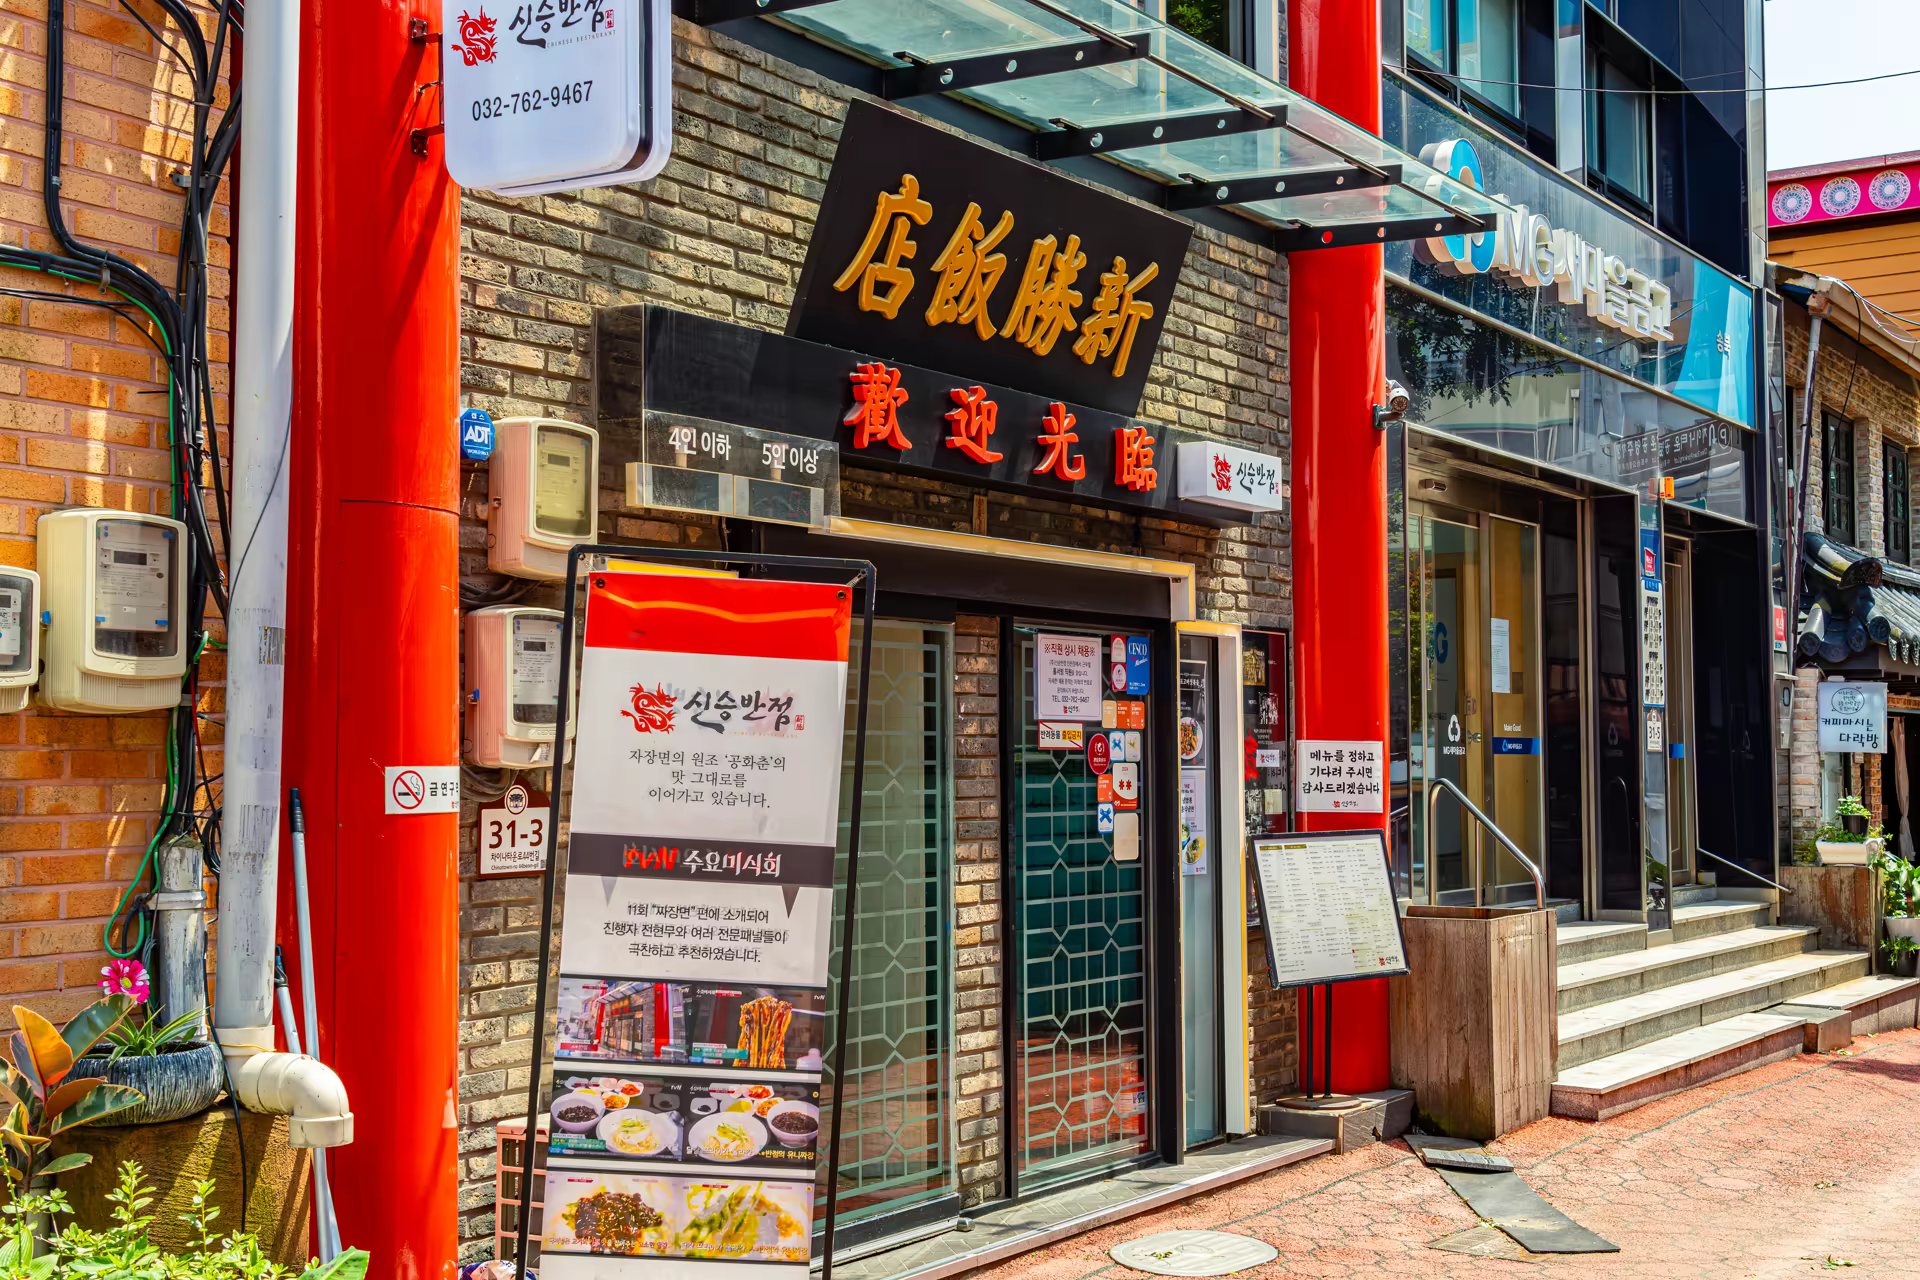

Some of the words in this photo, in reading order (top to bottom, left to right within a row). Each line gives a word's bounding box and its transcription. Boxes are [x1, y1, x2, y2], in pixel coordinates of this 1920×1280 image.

[546, 38, 573, 48] CHINESE
[576, 30, 616, 42] RESTAURANT
[472, 80, 593, 121] 032-762-9467
[464, 425, 490, 444] ADT
[668, 427, 697, 456] 4인
[700, 431, 732, 460] 이하
[762, 443, 786, 470] 5인
[789, 446, 818, 474] 이상
[1236, 462, 1275, 495] 신승반점
[682, 690, 794, 734] 신승반점
[1649, 726, 1660, 739] 31-5
[1821, 718, 1874, 732] 커피마시는
[1040, 730, 1060, 740] 반려동물
[1062, 730, 1082, 740] 출입금지
[1839, 733, 1879, 749] 다락방
[629, 750, 685, 766] 자장면의
[691, 752, 719, 767] 원조
[1310, 749, 1345, 762] 메뉴를
[1348, 750, 1374, 762] 정하고
[672, 770, 686, 785] 맛
[690, 772, 748, 788] 그대로를
[1310, 766, 1342, 778] 기다려
[1346, 766, 1373, 778] 주시면
[1302, 782, 1380, 794] 감사드리겠습니다
[649, 788, 704, 803] 이어가고
[711, 790, 770, 809] 있습니다.
[488, 818, 544, 849] 31-3
[491, 850, 540, 862] 차이나타운로44번길
[682, 850, 782, 878] 수요미식회
[723, 909, 769, 924] 소개되어
[603, 922, 638, 937] 진행자
[641, 924, 687, 940] 전현무와
[690, 928, 714, 940] 여러
[718, 928, 786, 944] 전문패널들이
[628, 943, 674, 958] 극찬하고
[678, 946, 761, 963] 추천하였습니다.
[787, 1150, 814, 1161] 유니짜장
